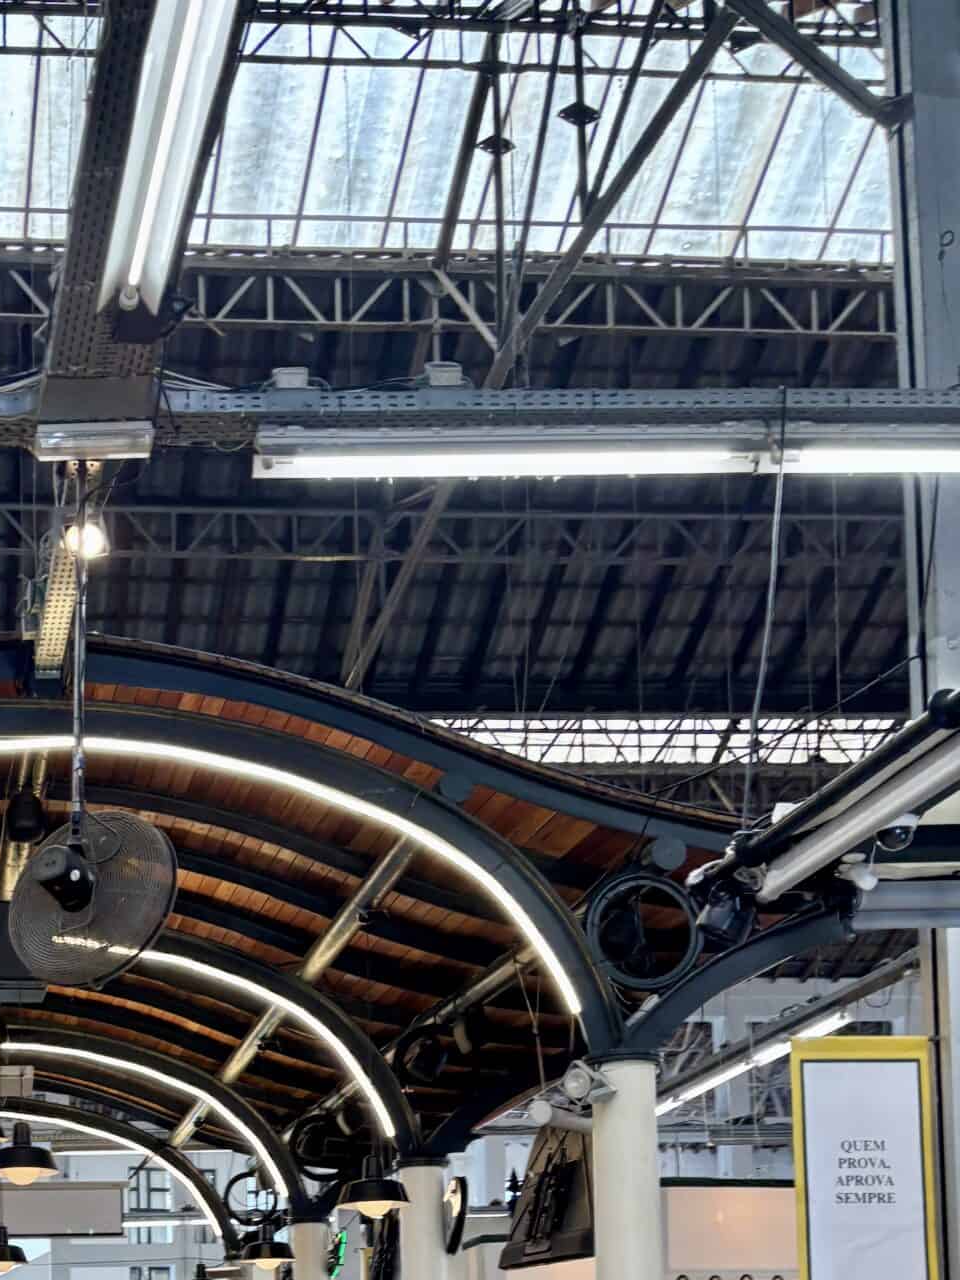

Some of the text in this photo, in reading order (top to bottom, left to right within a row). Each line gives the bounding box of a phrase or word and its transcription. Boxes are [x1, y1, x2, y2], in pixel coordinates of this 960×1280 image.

[840, 1139, 887, 1153] QUEM
[836, 1175, 895, 1186] APROVA
[836, 1192, 896, 1204] SEMPRE
